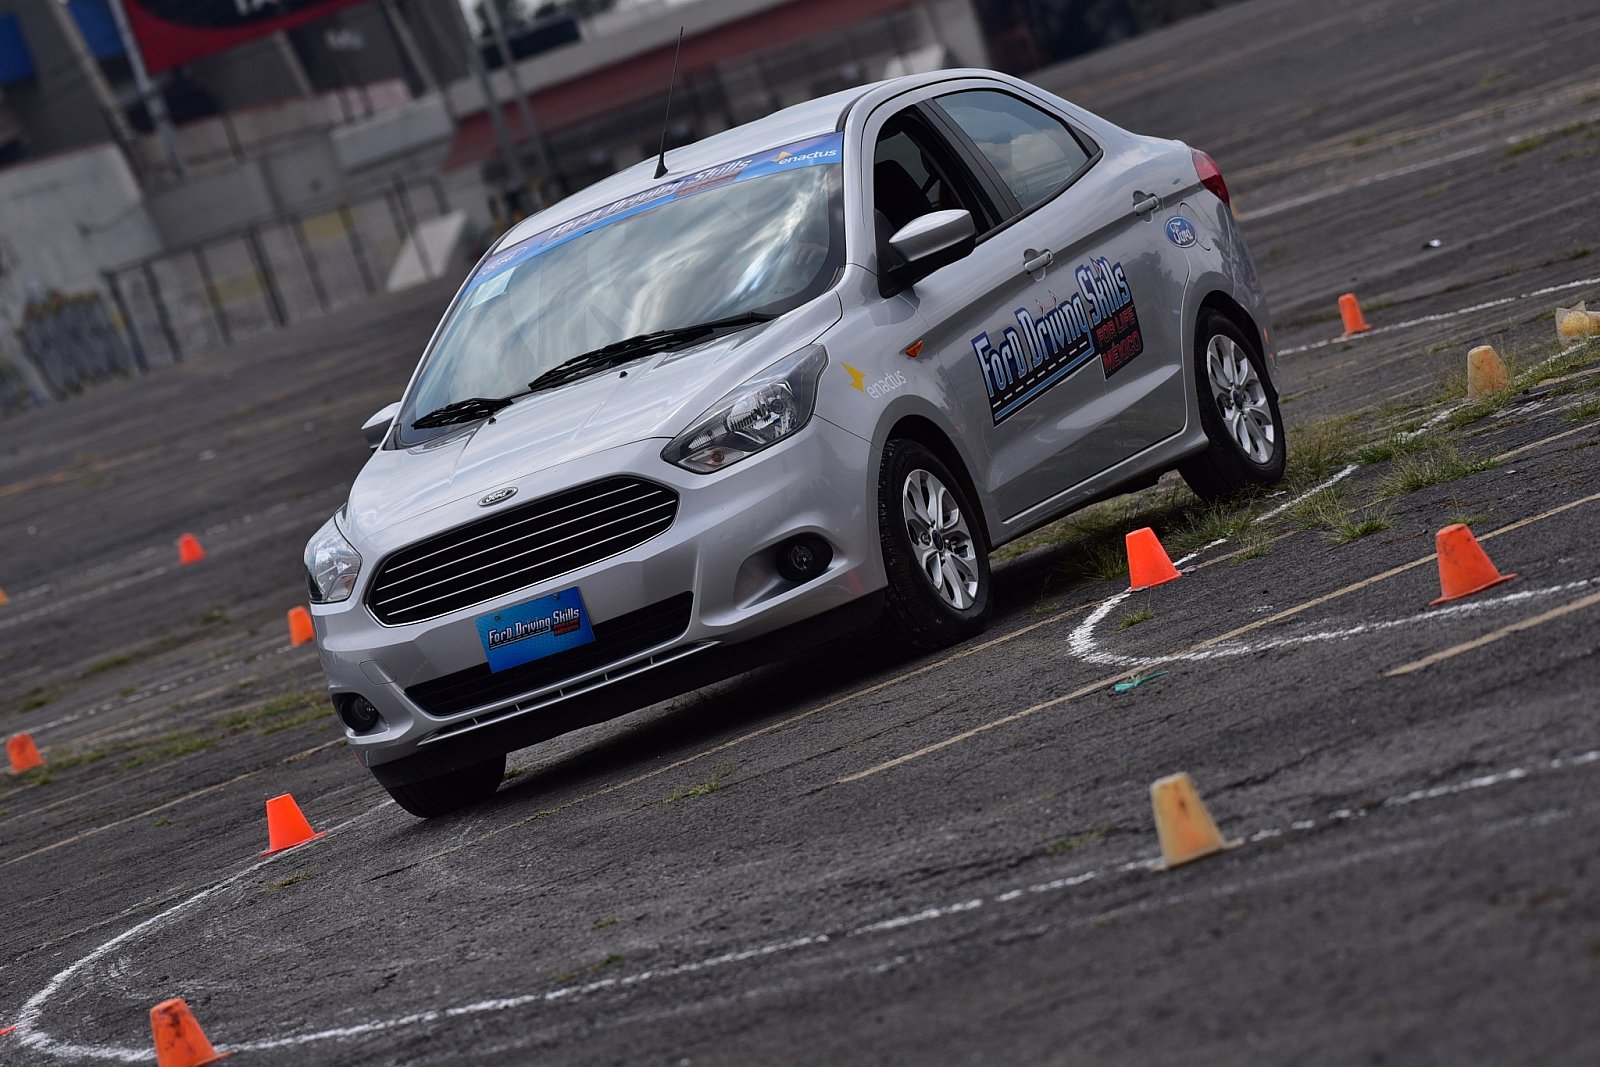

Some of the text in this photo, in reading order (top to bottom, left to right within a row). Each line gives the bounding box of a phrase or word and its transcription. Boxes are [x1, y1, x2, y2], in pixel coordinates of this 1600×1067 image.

[693, 159, 754, 181] Skills
[778, 149, 838, 165] enactus
[1014, 292, 1094, 367] Driving
[1075, 256, 1131, 326] Skills
[866, 370, 907, 399] enactus
[514, 617, 552, 635] Driving
[552, 607, 580, 625] Skills
